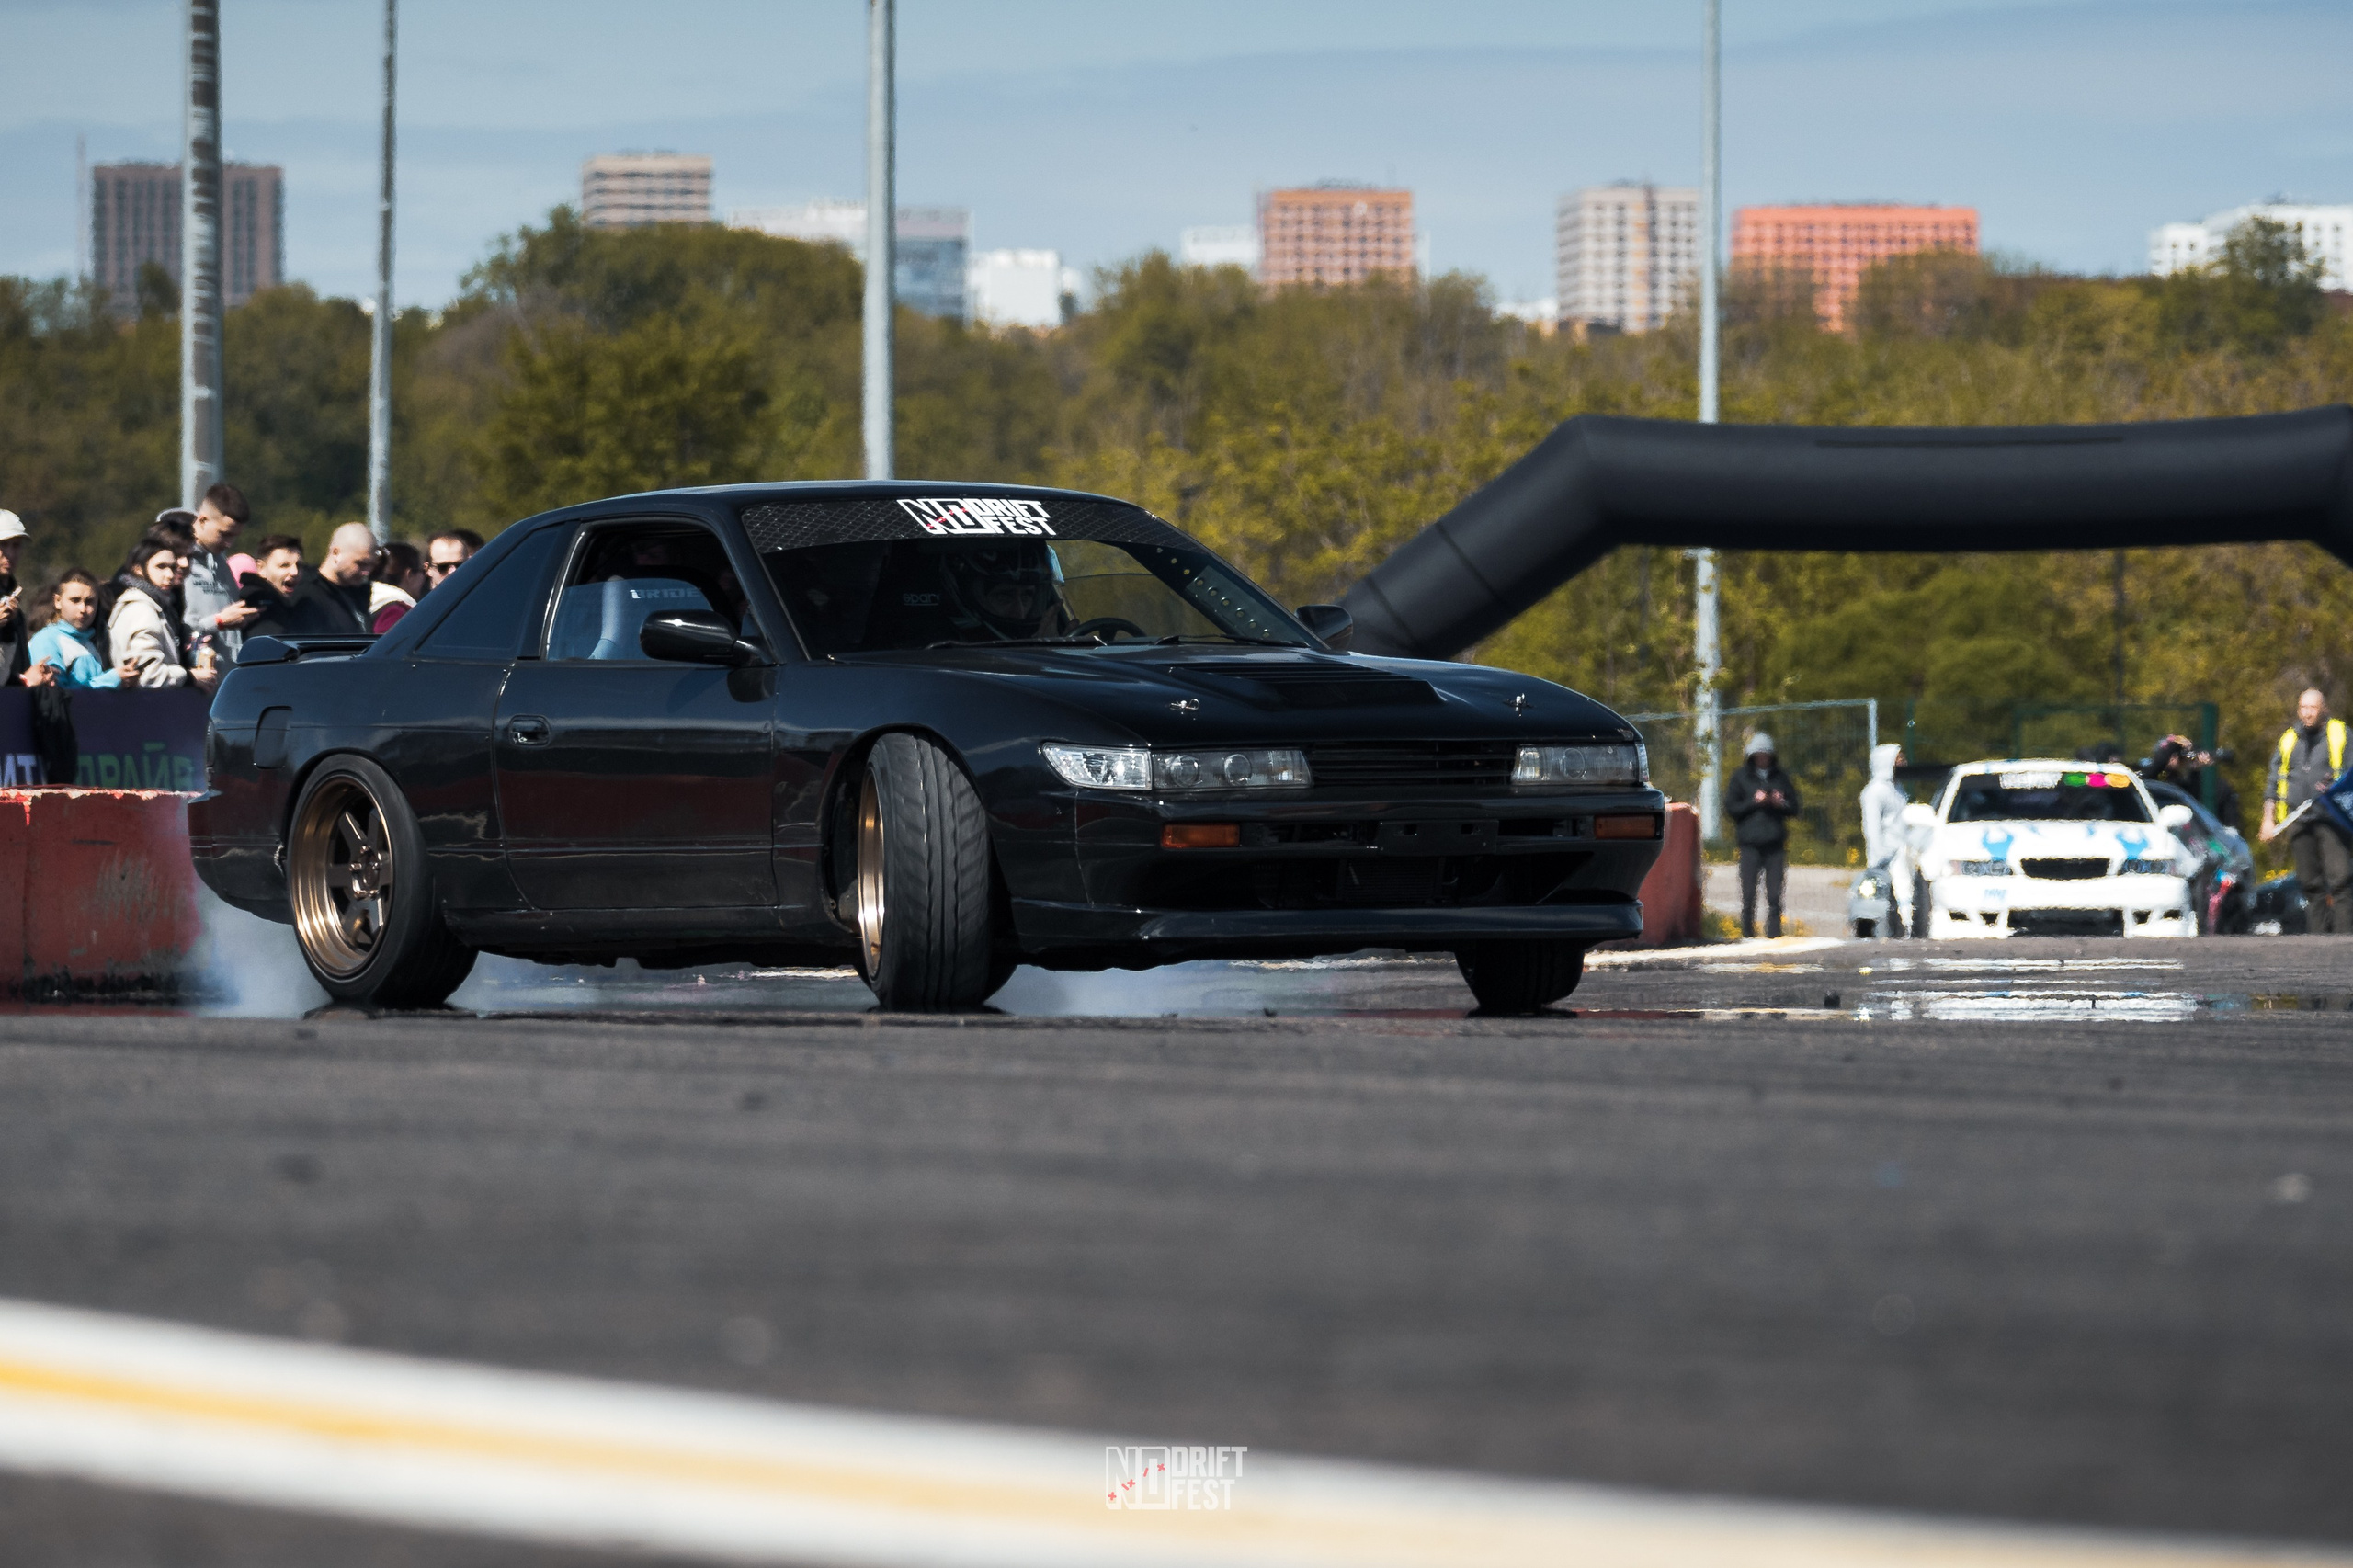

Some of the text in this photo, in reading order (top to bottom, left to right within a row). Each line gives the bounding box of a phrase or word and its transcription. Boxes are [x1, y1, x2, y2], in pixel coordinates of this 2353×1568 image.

[963, 499, 1051, 518] DRIFT
[981, 517, 1056, 536] FEST
[903, 592, 940, 605] spar
